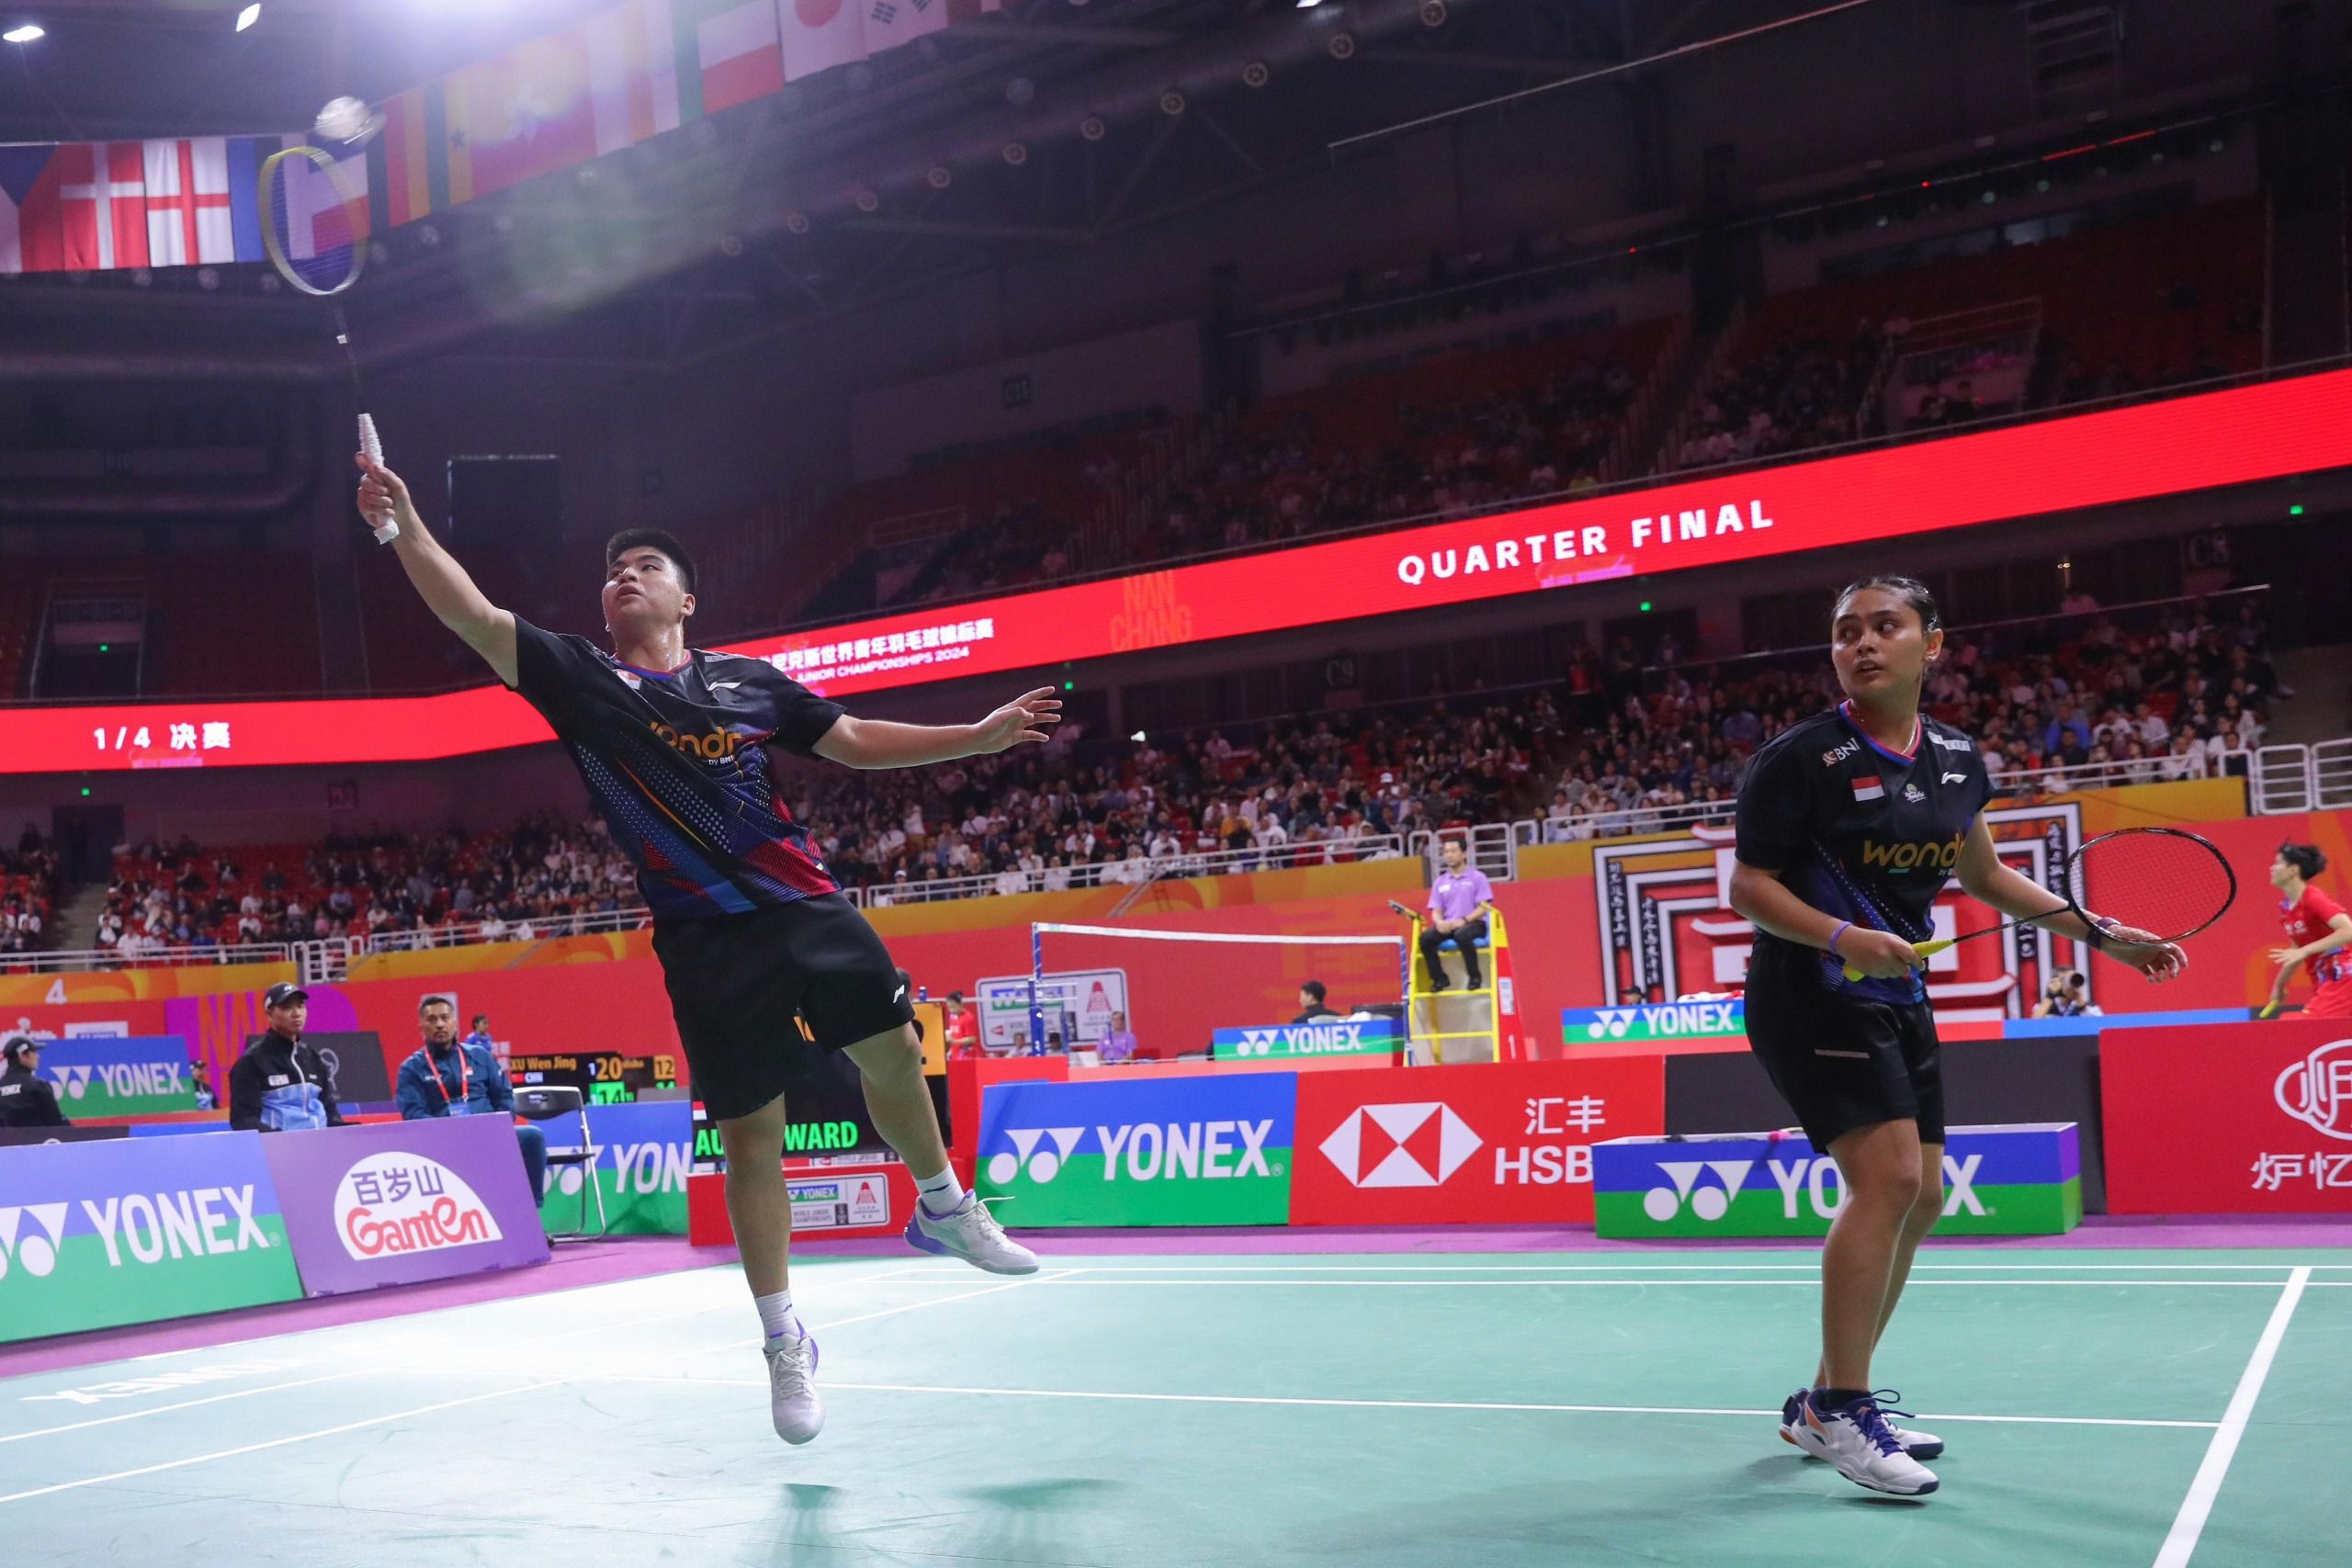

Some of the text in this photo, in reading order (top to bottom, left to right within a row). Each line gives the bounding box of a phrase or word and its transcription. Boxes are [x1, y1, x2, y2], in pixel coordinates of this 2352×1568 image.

[1397, 525, 1608, 585] QUARTER
[1631, 500, 1773, 548] FINAL
[1123, 570, 1176, 615] NAN
[1109, 604, 1193, 652] CHANG
[836, 651, 933, 678] CHAMPIONSHIPS
[934, 646, 969, 663] 2024
[94, 726, 152, 750] 1/4
[1837, 738, 1860, 761] BNI
[1863, 833, 1964, 868] wond
[45, 978, 68, 1005] 4
[1643, 1003, 1735, 1036] YONEX
[1283, 1025, 1363, 1054] YONEX
[527, 1057, 551, 1071] Wen
[553, 1055, 576, 1071] Jing
[596, 1057, 623, 1080] 20
[656, 1060, 674, 1077] 12
[97, 1063, 185, 1097] YONEX
[601, 1089, 624, 1104] 14
[1524, 1095, 1607, 1135] 汇丰
[1095, 1119, 1274, 1181] YONEX
[350, 1165, 446, 1206] 百岁山
[804, 1187, 836, 1200] YONEX
[81, 1184, 271, 1268] YONEX
